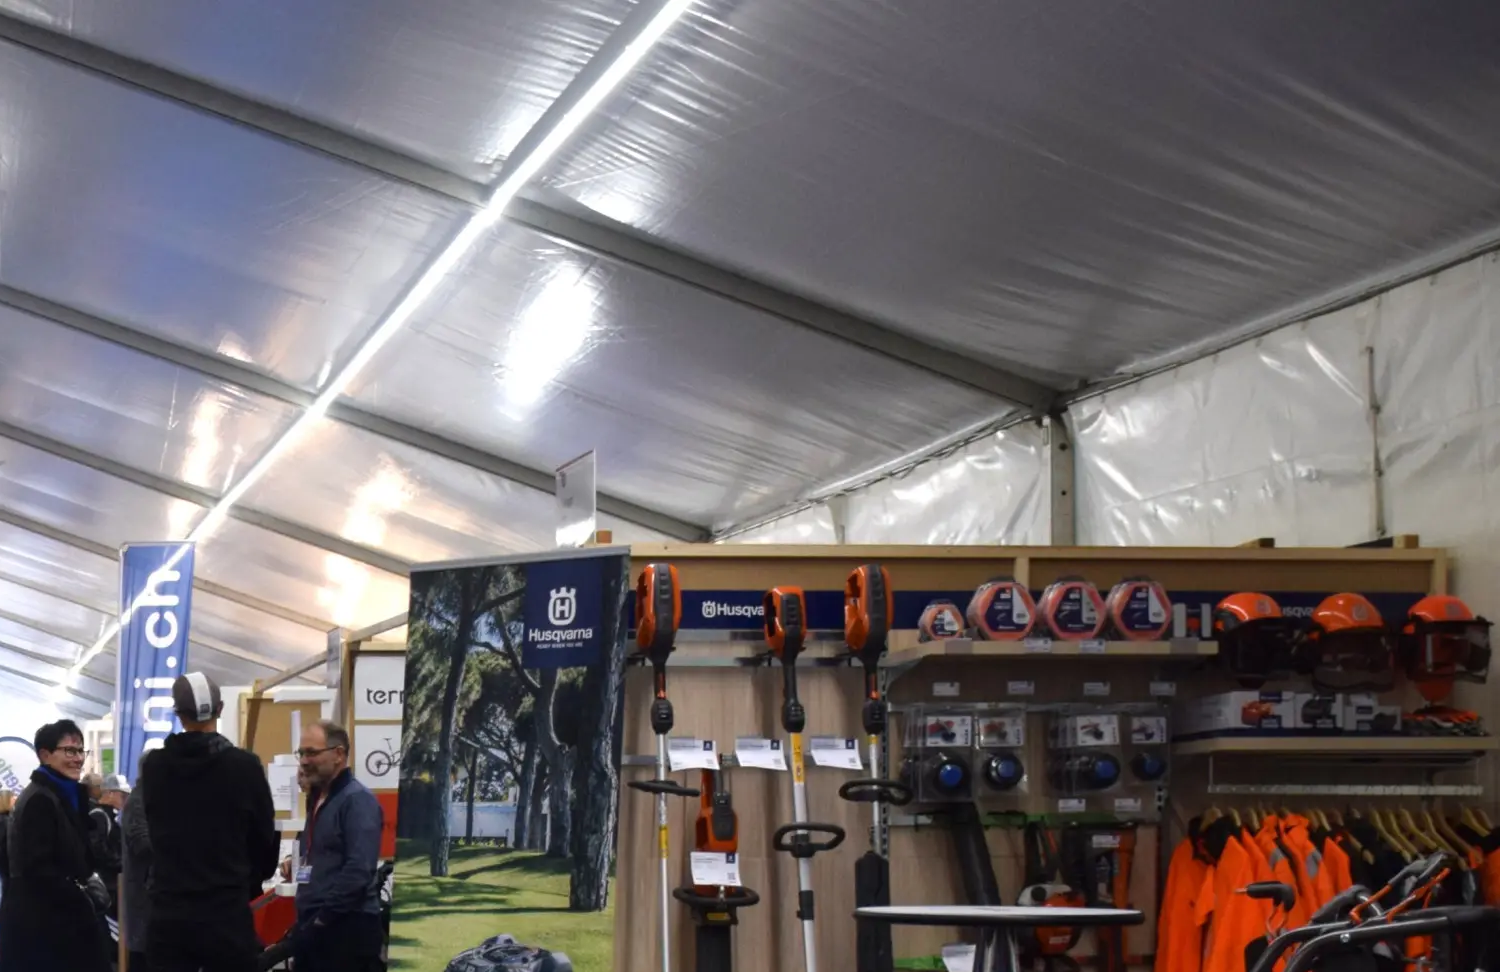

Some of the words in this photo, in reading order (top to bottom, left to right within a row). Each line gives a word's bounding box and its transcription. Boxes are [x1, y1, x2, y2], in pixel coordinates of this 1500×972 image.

[717, 603, 765, 618] Husqva
[529, 628, 593, 642] Husqvarna
[366, 688, 405, 705] terr
